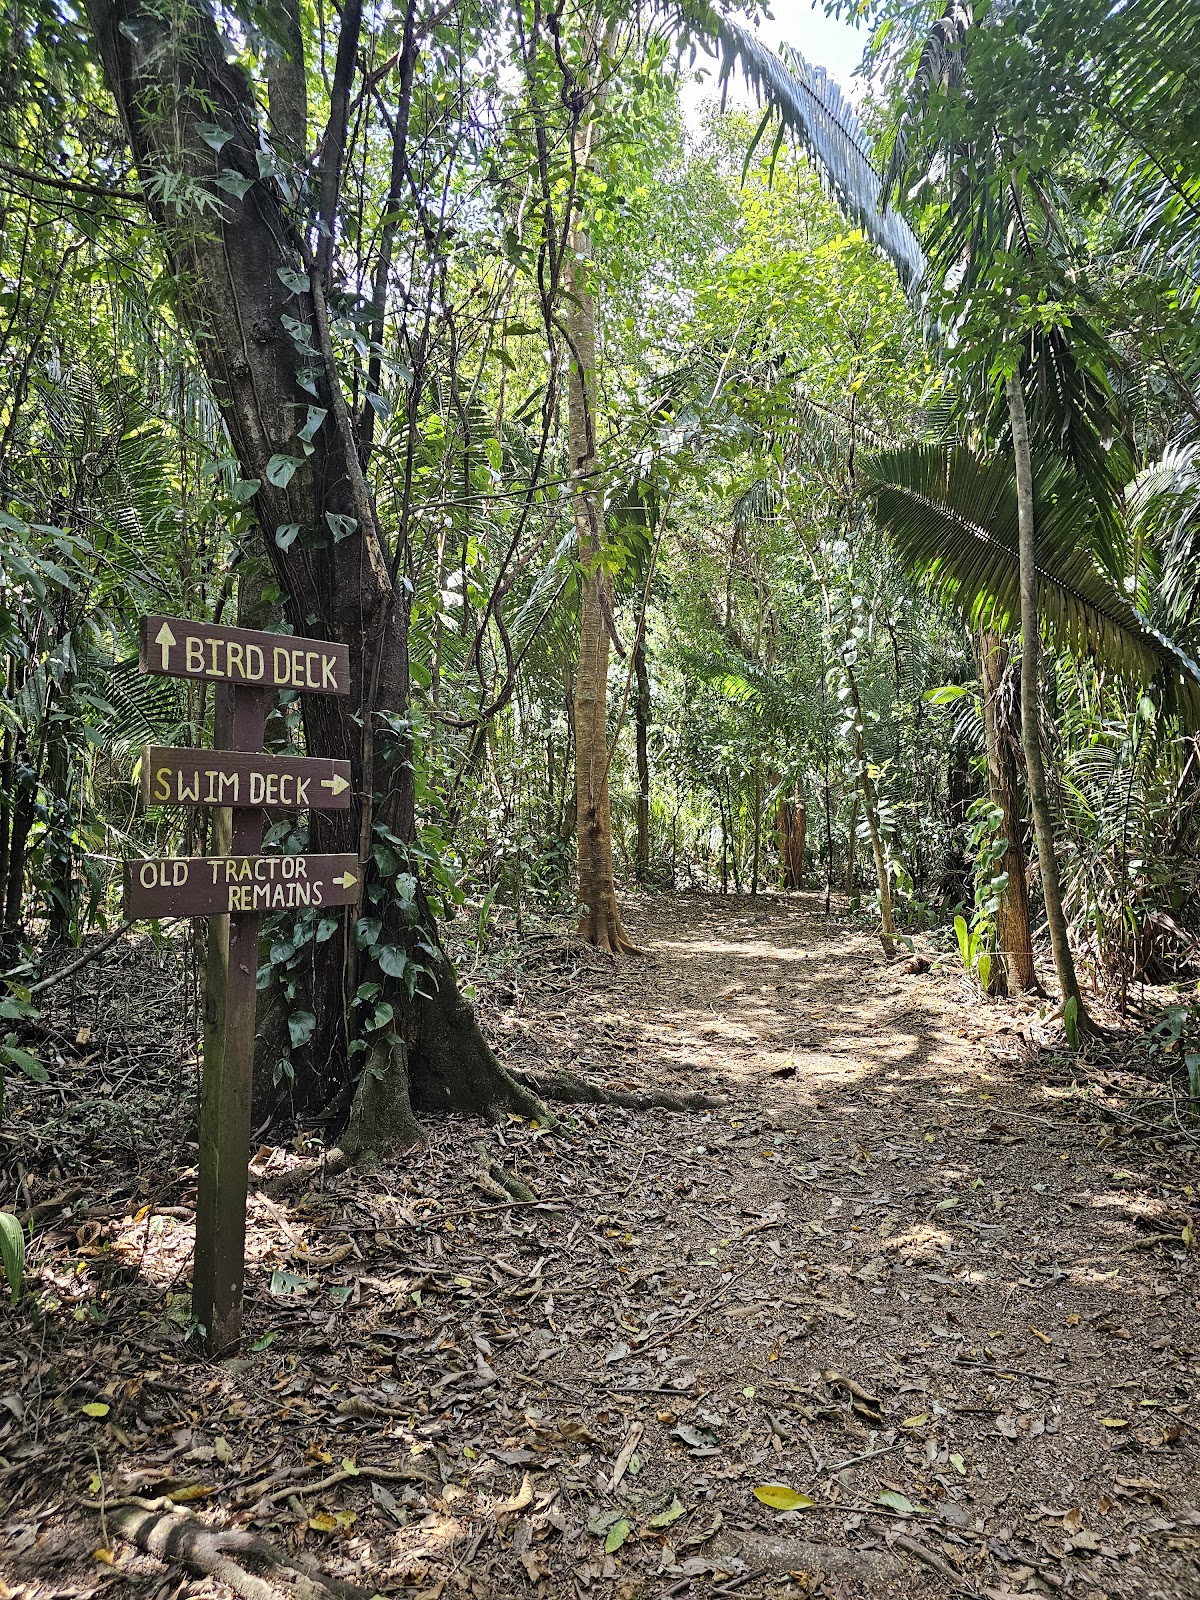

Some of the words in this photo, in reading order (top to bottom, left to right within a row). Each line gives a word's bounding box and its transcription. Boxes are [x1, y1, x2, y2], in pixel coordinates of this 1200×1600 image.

[186, 636, 265, 681] BIRD
[273, 647, 338, 689] DECK
[154, 767, 239, 803] SWIM
[250, 772, 311, 805] DECK
[139, 861, 189, 888] OLD
[206, 856, 307, 884] TRACTOR
[228, 881, 323, 911] REMAINS
